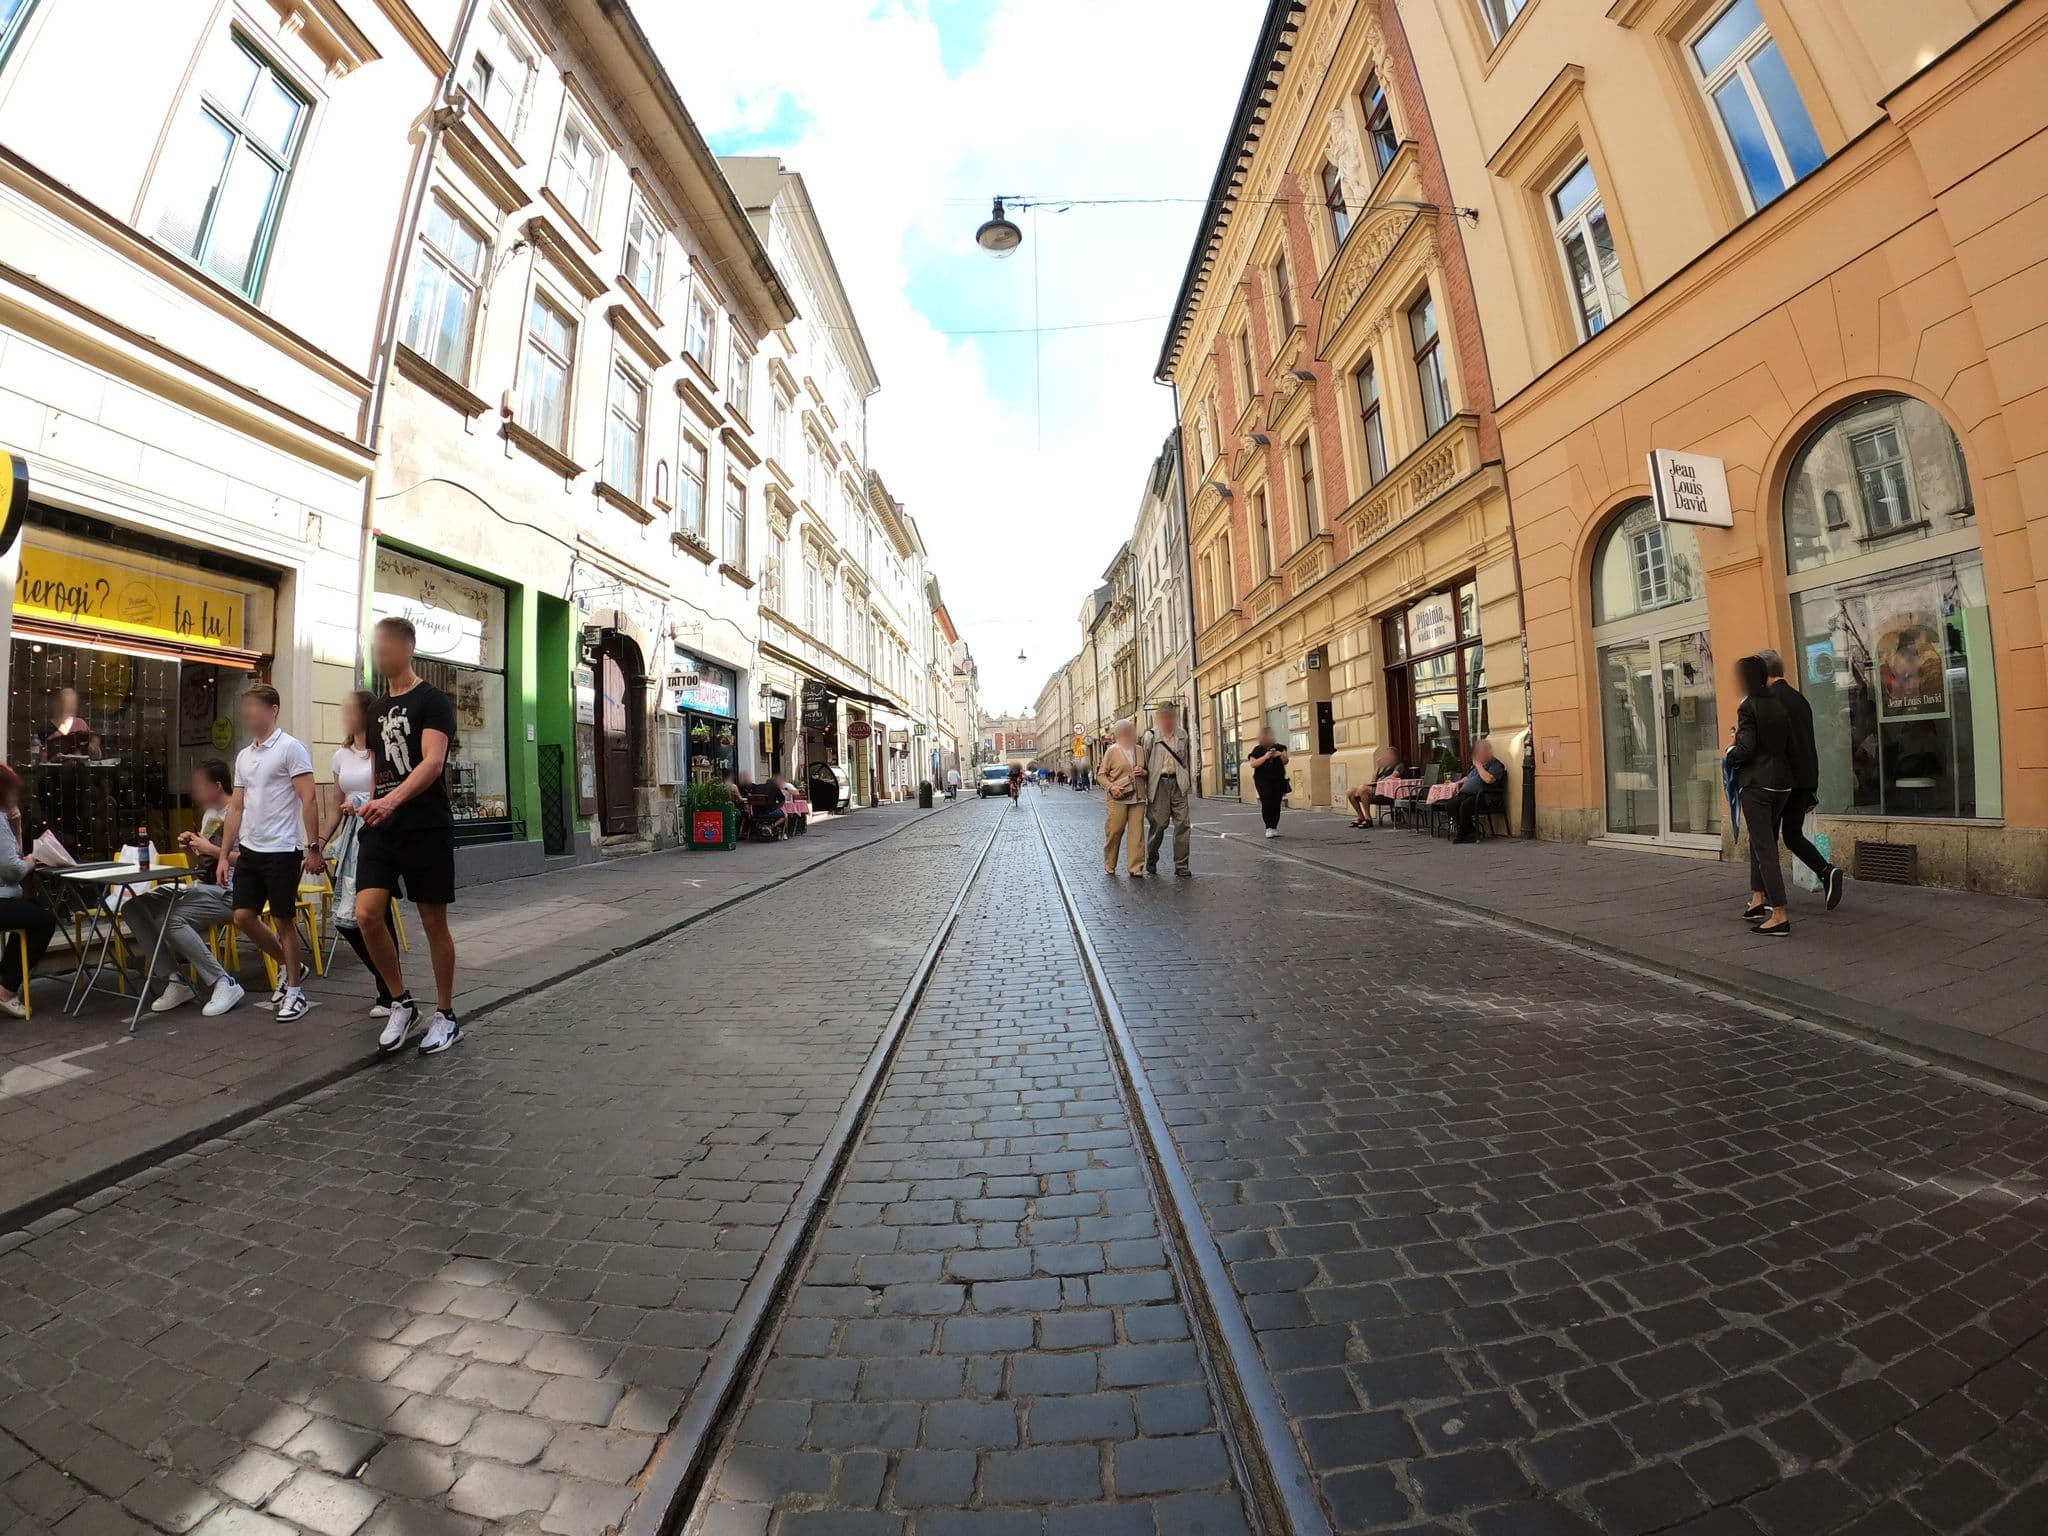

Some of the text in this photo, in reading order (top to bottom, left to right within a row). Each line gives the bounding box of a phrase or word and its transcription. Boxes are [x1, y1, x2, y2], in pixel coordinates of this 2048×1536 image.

[1669, 459, 1696, 478] Jean
[1671, 475, 1703, 496] Louis
[1674, 492, 1708, 512] David
[174, 595, 195, 637] to
[1416, 606, 1444, 630] Pijalnia
[667, 675, 698, 687] TATTOO
[1888, 693, 1942, 708] Jean Louis David
